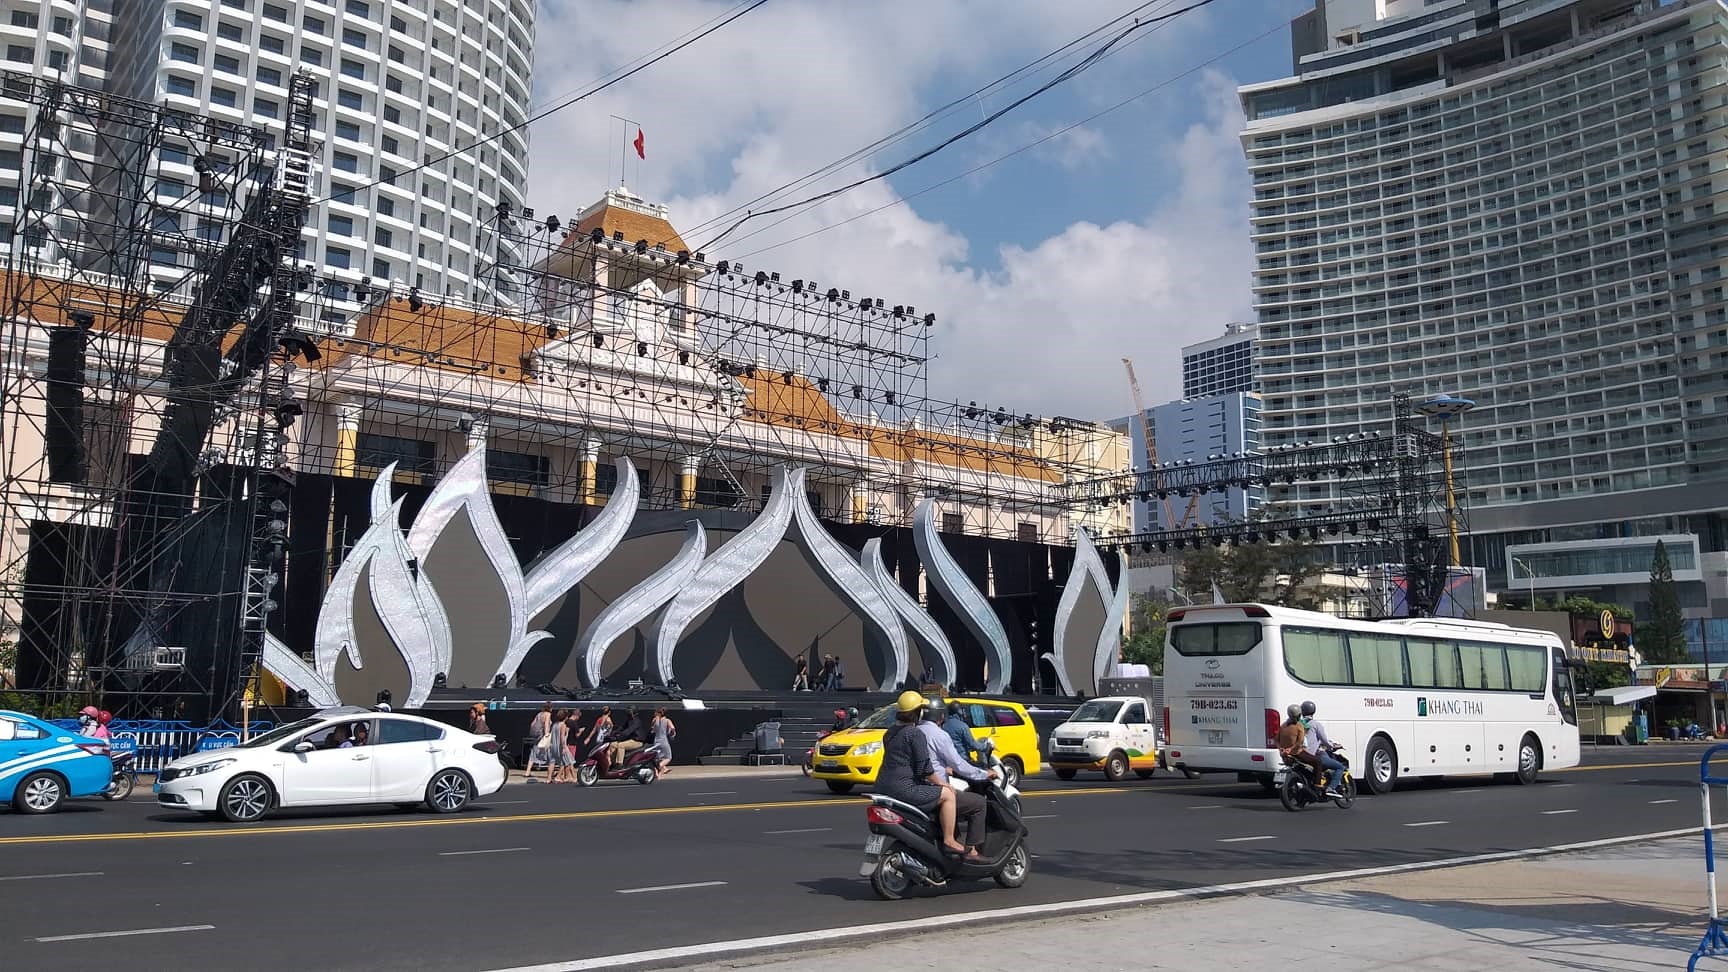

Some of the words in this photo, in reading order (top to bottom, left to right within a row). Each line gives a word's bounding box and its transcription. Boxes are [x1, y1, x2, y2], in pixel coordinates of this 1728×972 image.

[1191, 699, 1238, 710] 79B-023.63
[1363, 697, 1394, 708] 79B-023.63
[1428, 700, 1461, 715] KHANG
[1463, 701, 1484, 716] THAI
[1198, 716, 1221, 724] KHANG
[1223, 716, 1238, 724] THAI
